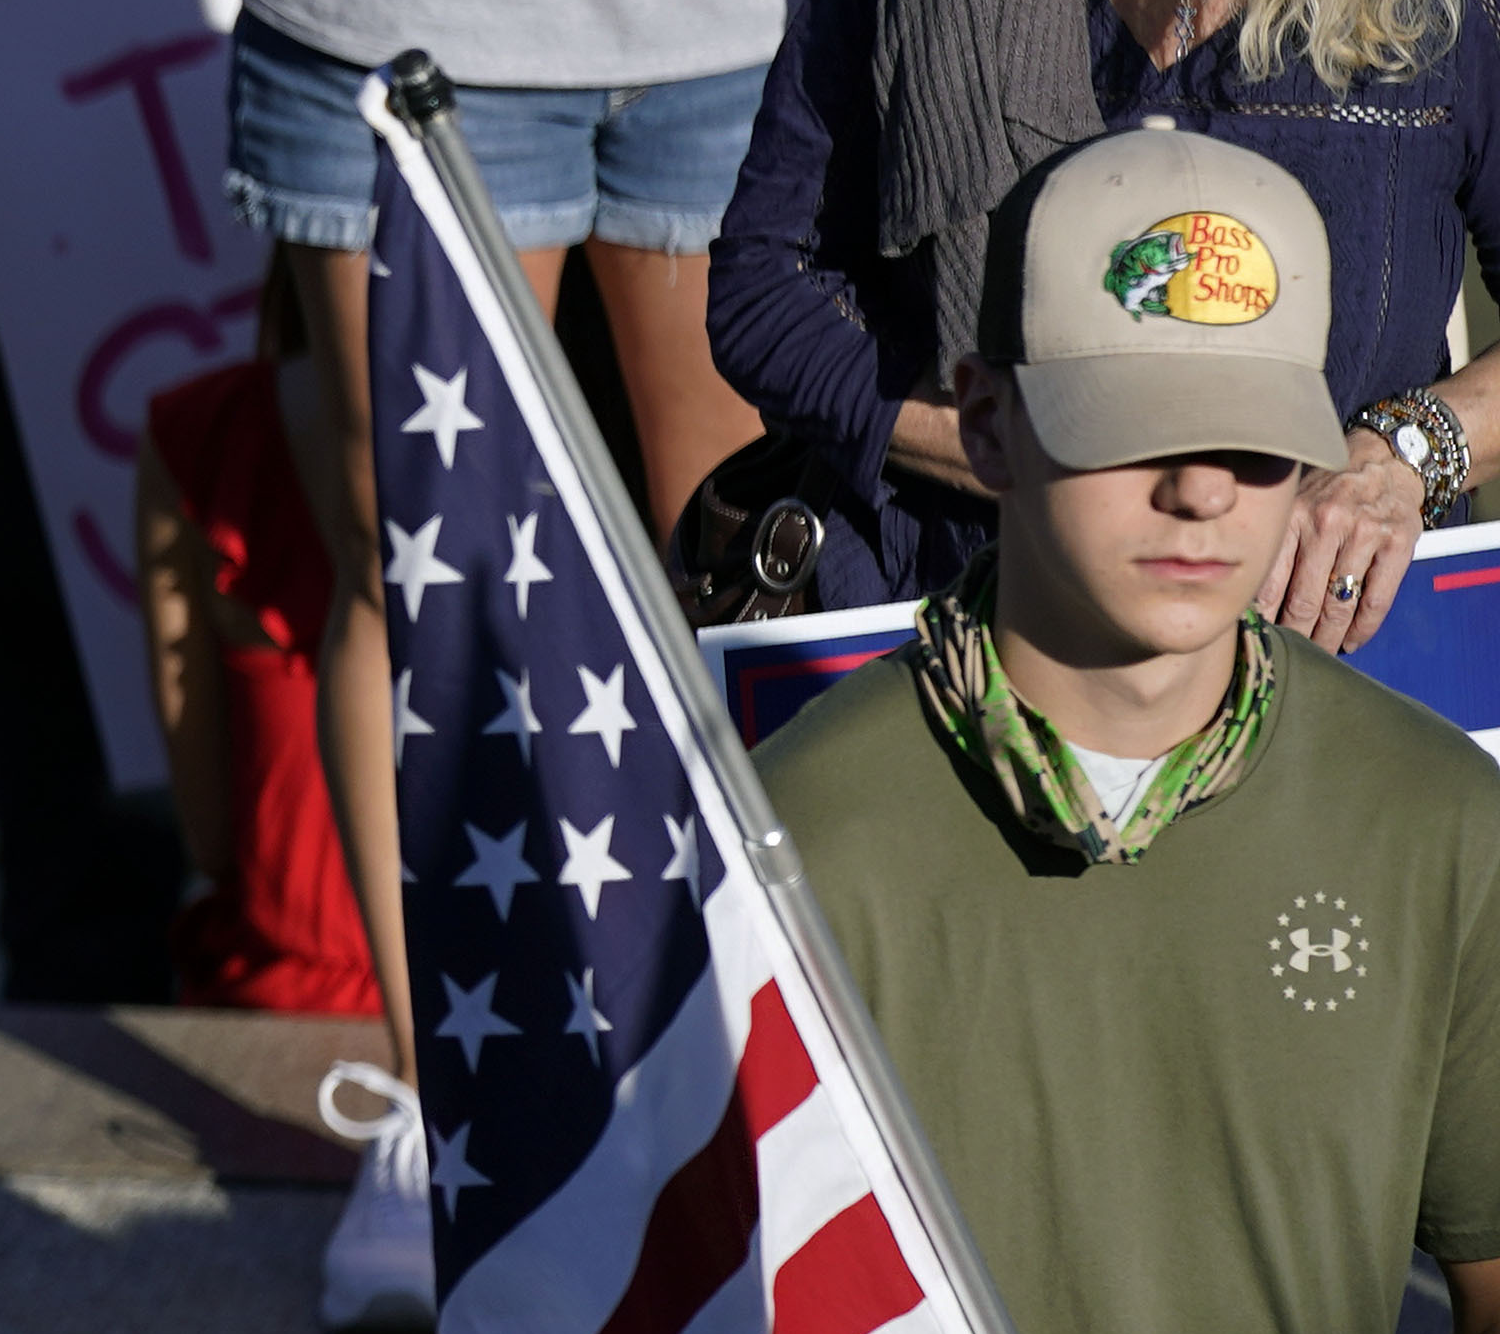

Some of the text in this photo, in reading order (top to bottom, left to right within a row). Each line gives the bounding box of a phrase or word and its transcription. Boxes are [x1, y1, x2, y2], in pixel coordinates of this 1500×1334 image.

[1188, 215, 1252, 251] Bass
[1195, 246, 1240, 275] Pro
[1194, 273, 1270, 313] Shops
